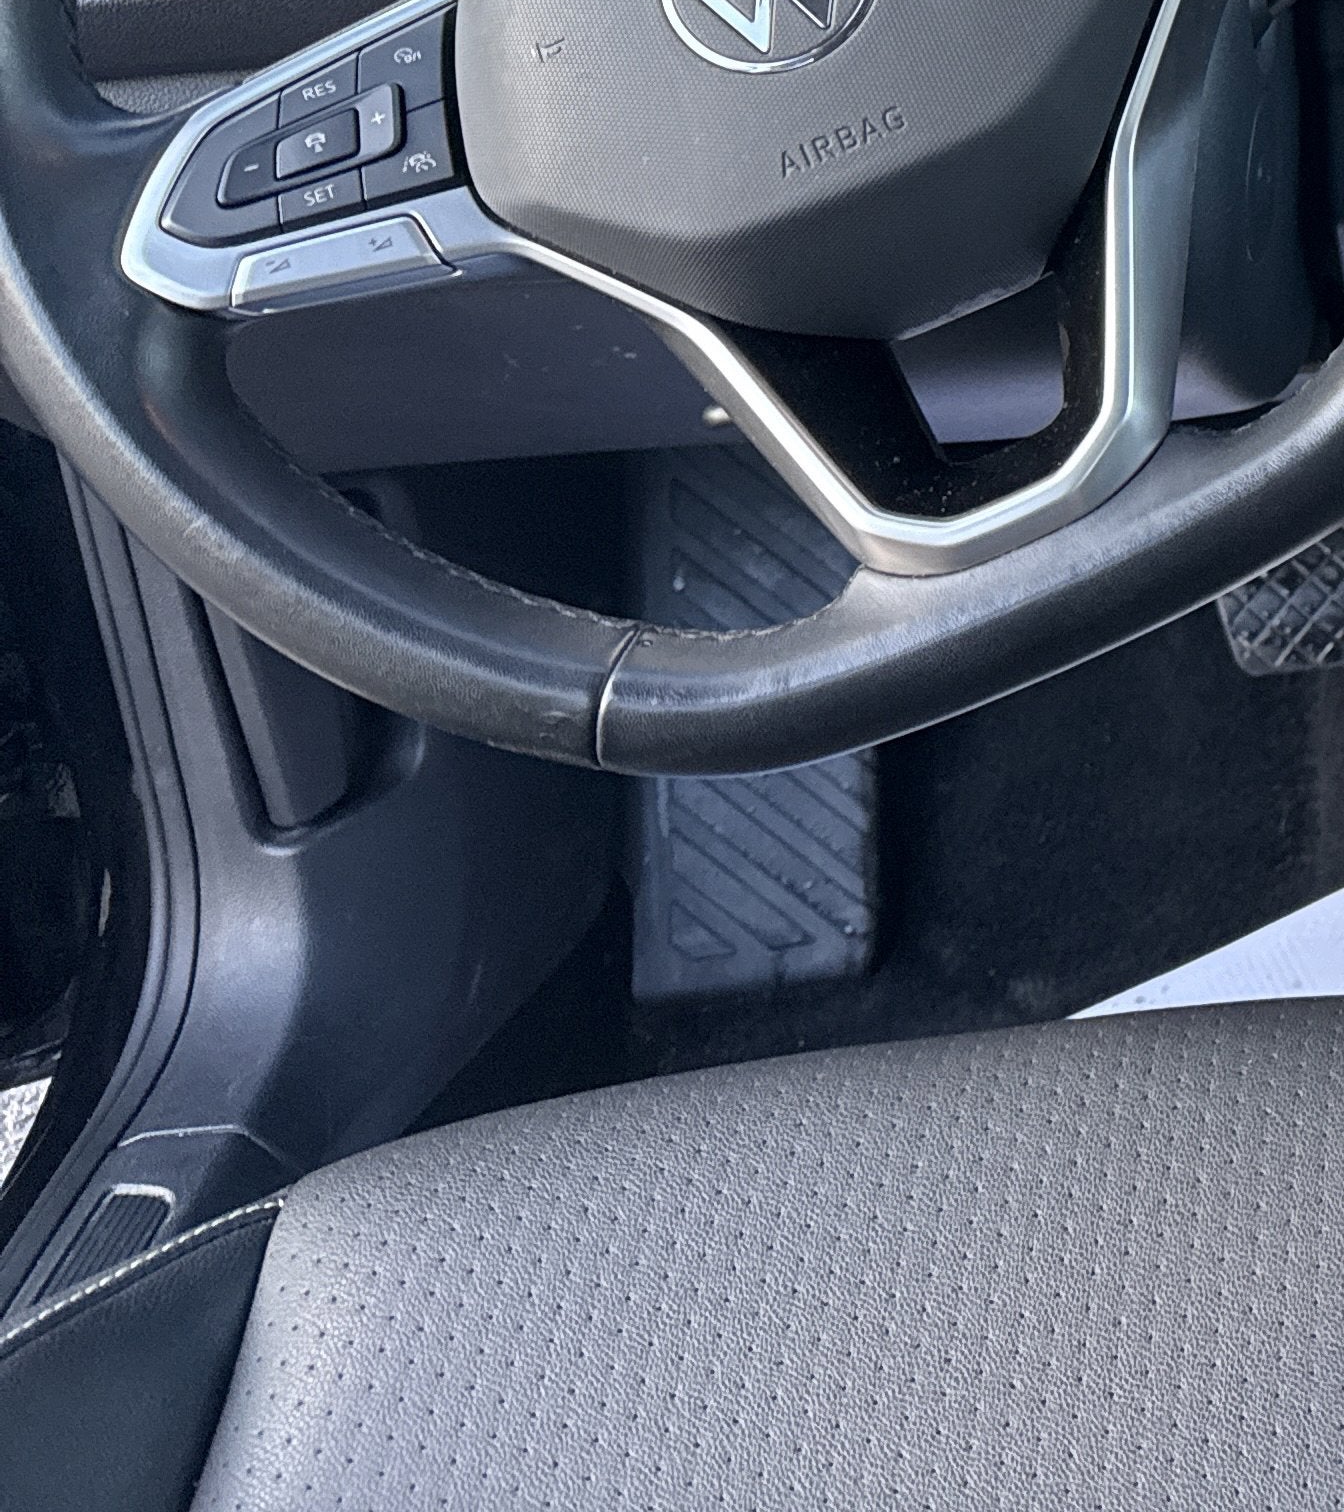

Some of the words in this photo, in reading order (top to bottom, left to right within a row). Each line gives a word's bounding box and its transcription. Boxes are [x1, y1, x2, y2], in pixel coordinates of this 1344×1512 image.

[302, 80, 337, 101] RES
[779, 105, 906, 178] AIRBAG
[303, 184, 336, 207] SET
